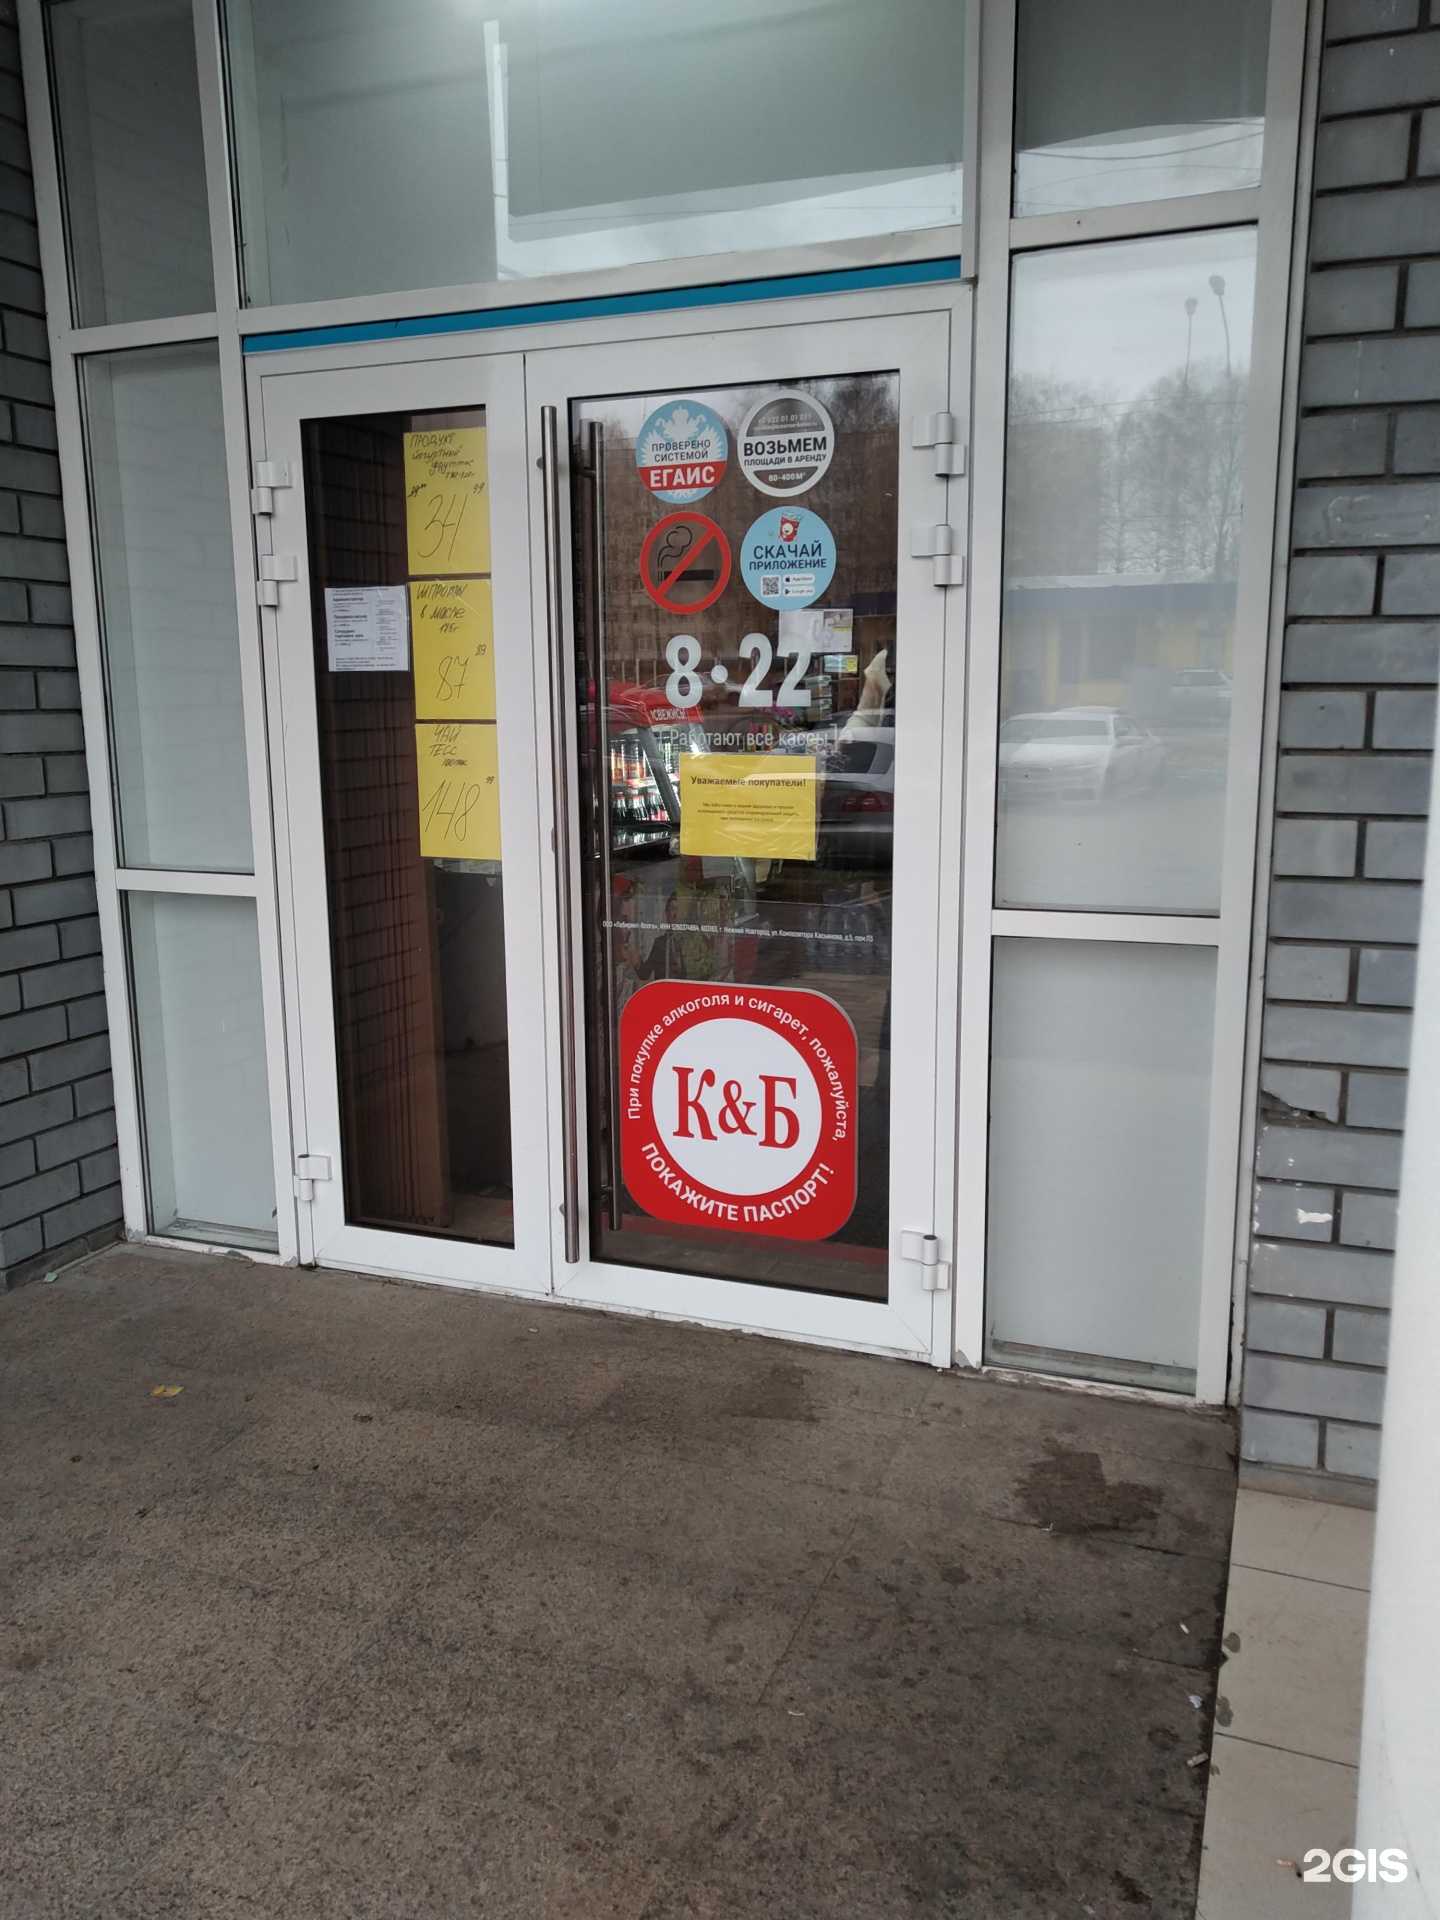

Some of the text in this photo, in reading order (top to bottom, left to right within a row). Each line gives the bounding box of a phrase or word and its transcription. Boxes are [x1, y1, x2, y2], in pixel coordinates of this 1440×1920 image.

[651, 440, 711, 452] ПРОВЕРЕНО
[743, 436, 827, 457] ВОЗЬМЕМ
[654, 450, 709, 462] СИСТЕМОЙ
[744, 453, 827, 466] ПЛОЩАДИ В АРЕНДУ
[649, 466, 716, 488] ЕГАИС
[753, 540, 822, 560] СКАЧАЙ
[749, 558, 828, 571] ПРИЛОЖЕНИЕ
[670, 730, 829, 747] Работают все кассы
[690, 776, 807, 788] Уважаемые покупатели!
[627, 994, 850, 1142] При покупке алкоголя и сигарет, пожалуйста,
[671, 1065, 801, 1149] К&Б
[640, 1142, 836, 1223] ПОКАЖИТЕ ПАСПОРТ!
